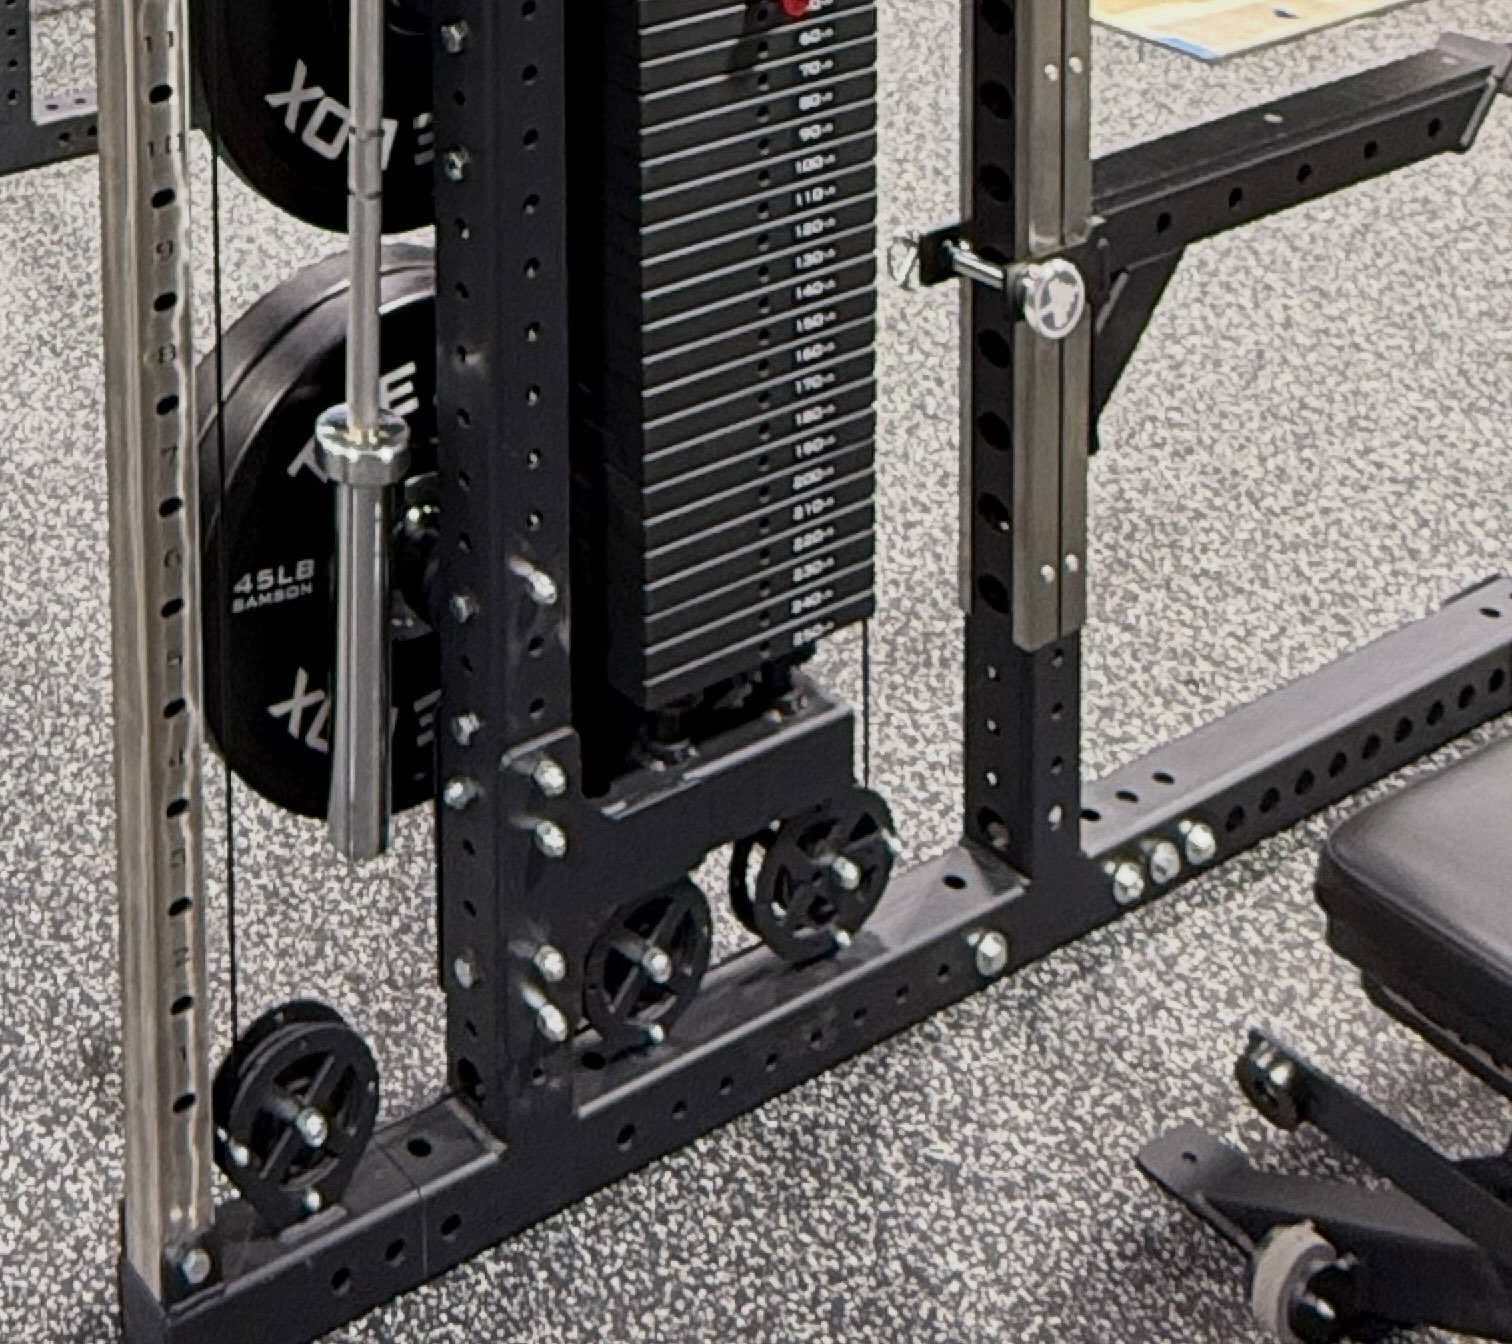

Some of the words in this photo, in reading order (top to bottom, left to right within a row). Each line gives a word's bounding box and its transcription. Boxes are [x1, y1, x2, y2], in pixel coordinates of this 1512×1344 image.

[144, 30, 174, 53] 11
[233, 559, 315, 594] 45LB
[232, 582, 312, 614] SAMSON
